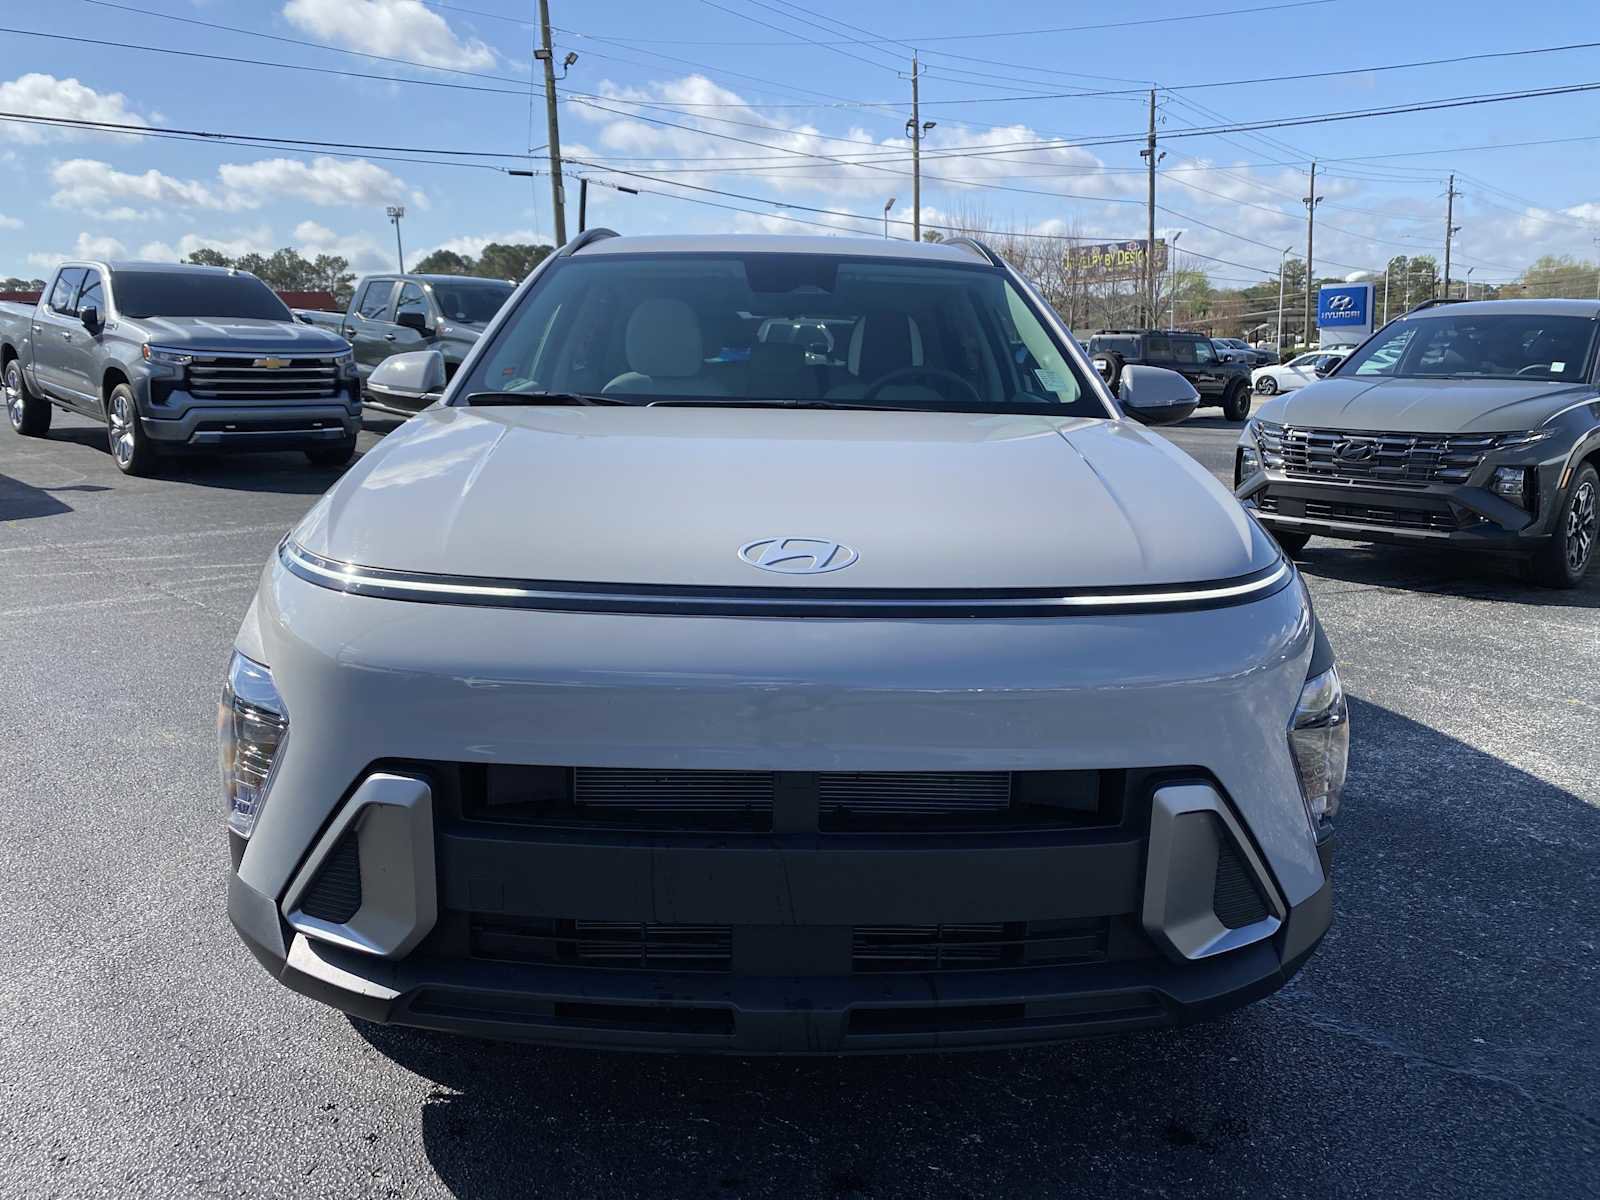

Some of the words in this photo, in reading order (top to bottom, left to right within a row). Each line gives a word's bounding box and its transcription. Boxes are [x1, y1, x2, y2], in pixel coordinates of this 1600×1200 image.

[1066, 252, 1104, 269] JELRY
[1104, 252, 1115, 266] BY
[1321, 310, 1360, 319] HYUNDAI
